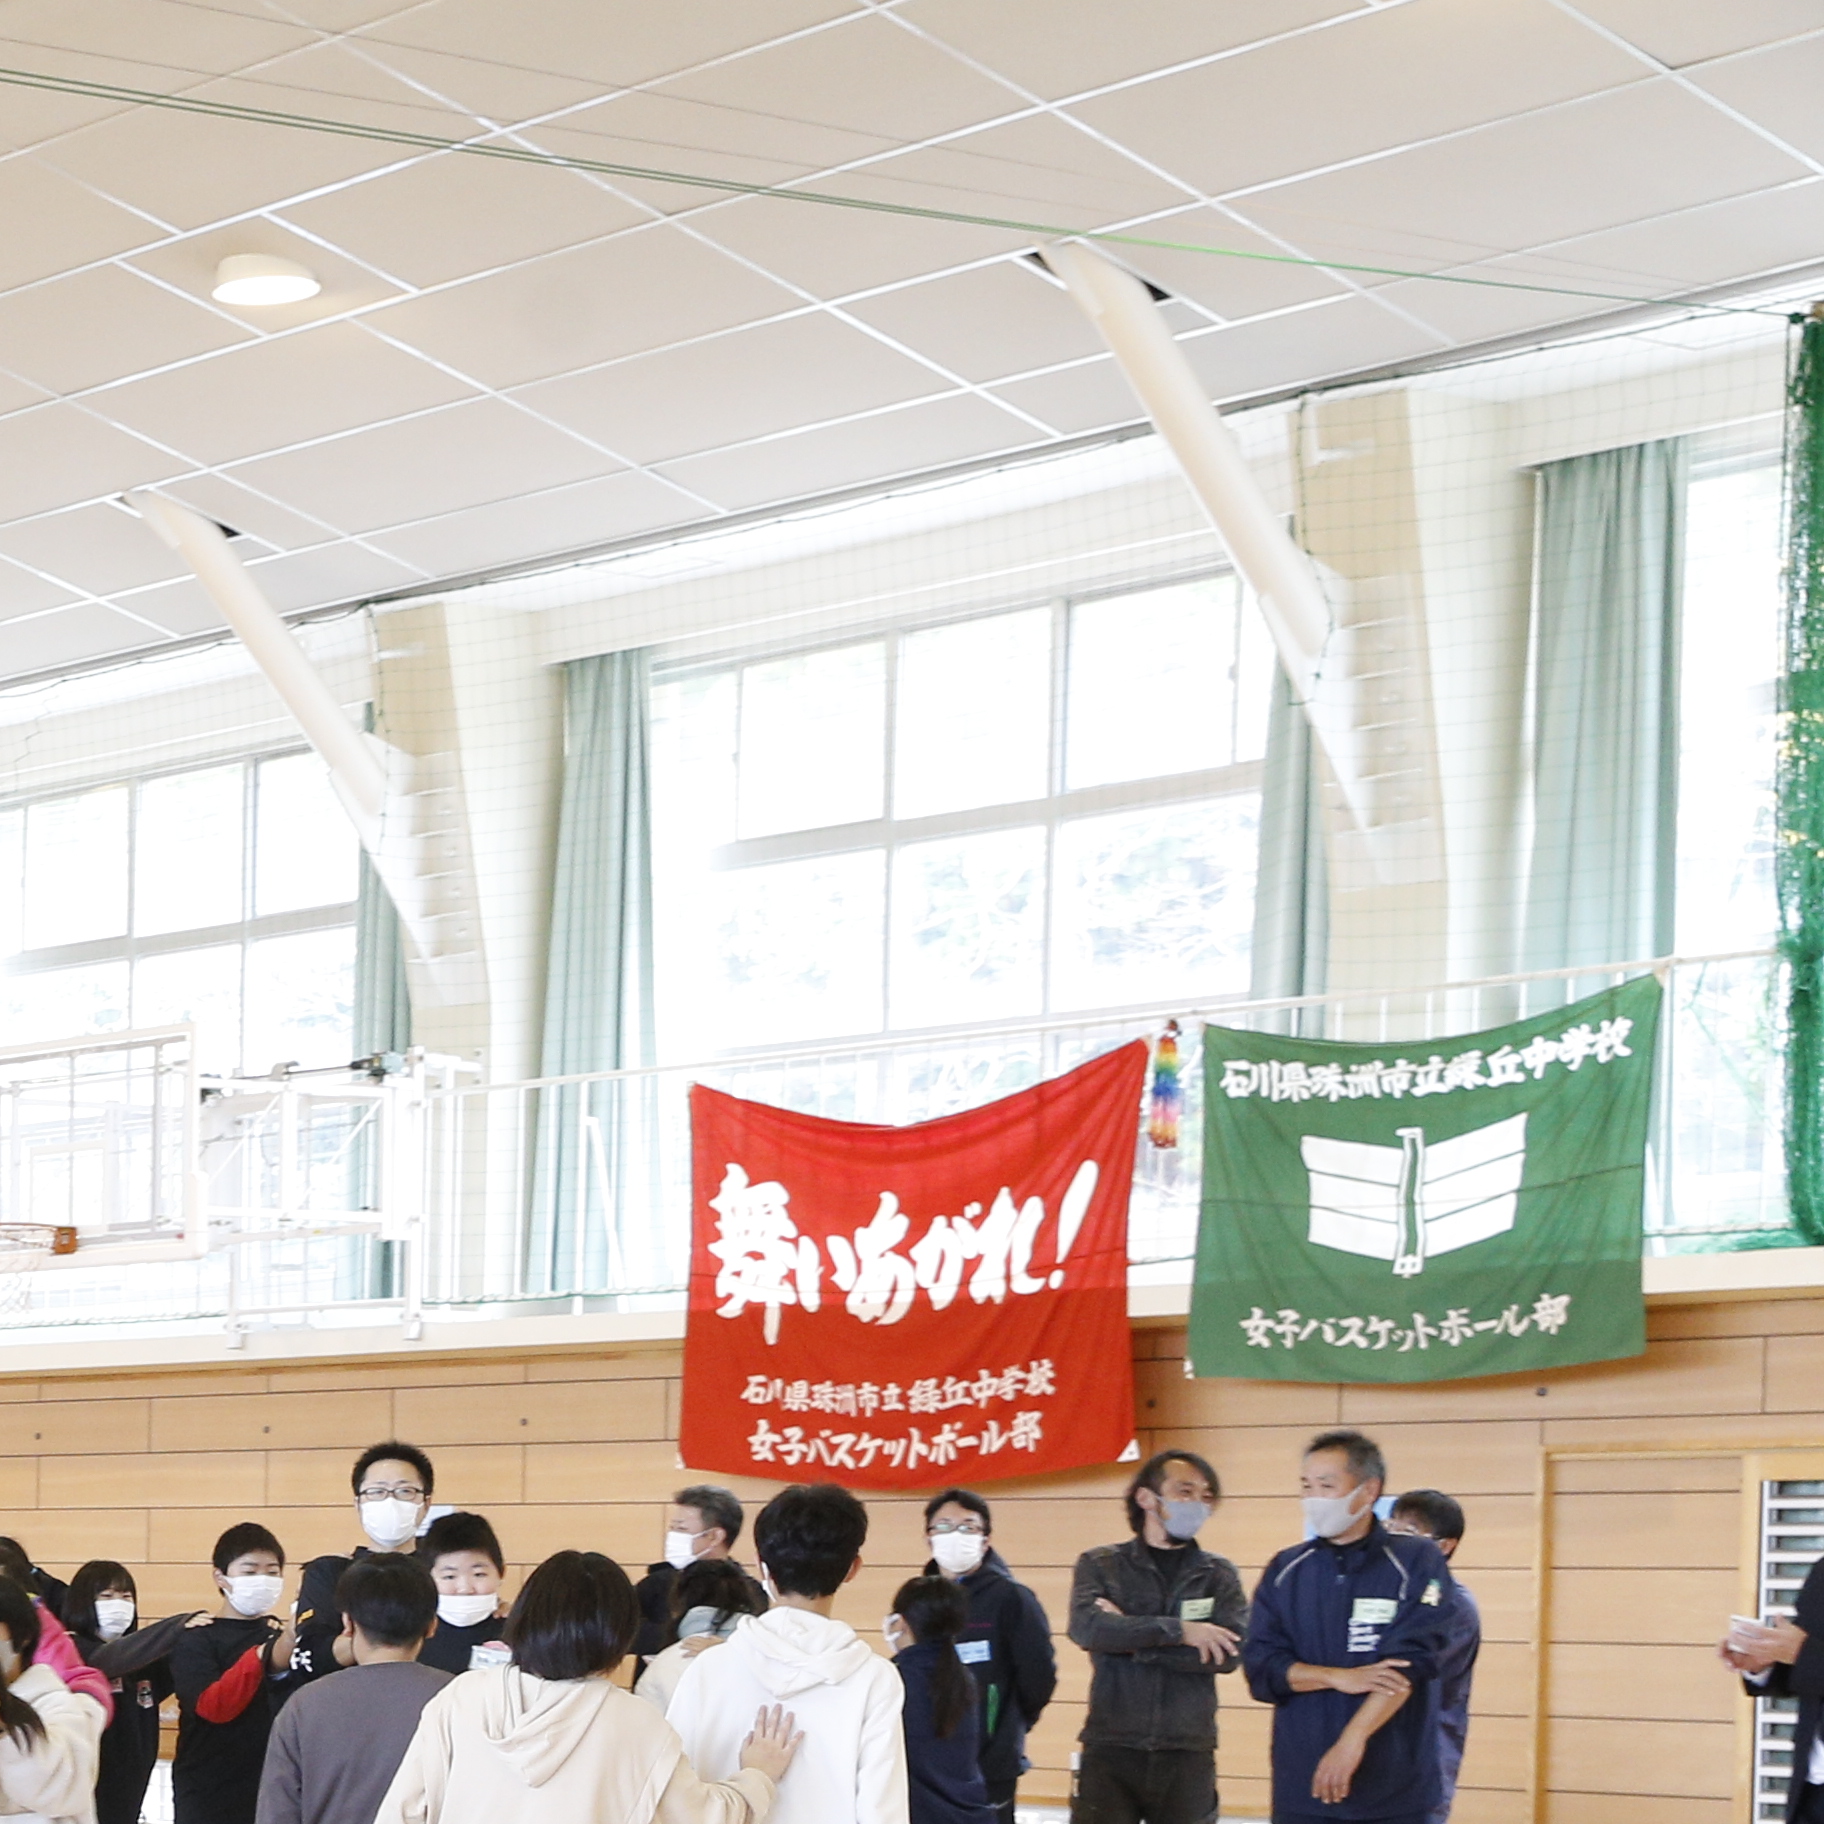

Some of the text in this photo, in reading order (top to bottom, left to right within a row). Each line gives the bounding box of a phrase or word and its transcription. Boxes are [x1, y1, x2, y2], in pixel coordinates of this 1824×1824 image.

[1219, 1016, 1633, 1102] 石川県珠洲市立緑丘中学校
[708, 1160, 1100, 1345] 舞いあがれ!
[1239, 1293, 1572, 1352] 女子バスケットボール部
[740, 1358, 1056, 1418] 石川県珠洲市立緑丘中学校
[747, 1410, 1044, 1469] 女子バスケットボール部
